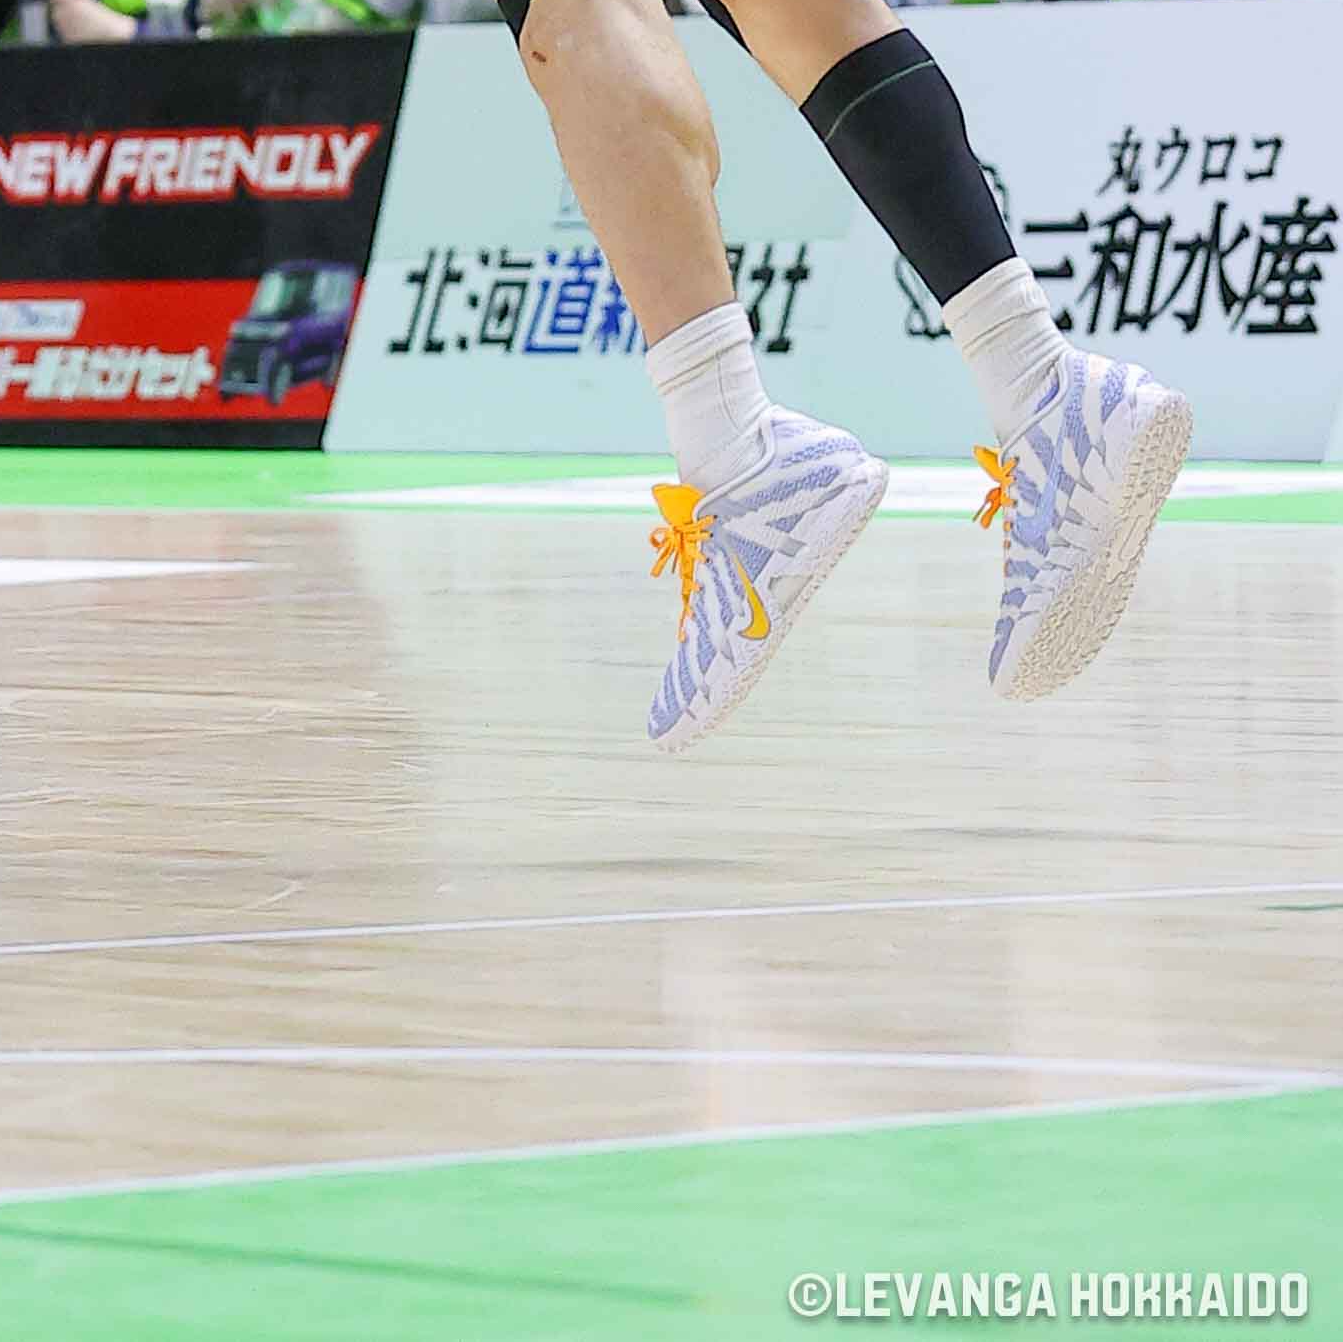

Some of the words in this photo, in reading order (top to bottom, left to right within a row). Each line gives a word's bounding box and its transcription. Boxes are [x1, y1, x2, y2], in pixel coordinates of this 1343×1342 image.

[104, 130, 371, 197] FRIENDLY
[1097, 125, 1283, 196] 丸ウロコ
[1024, 197, 1340, 335] 三和水産
